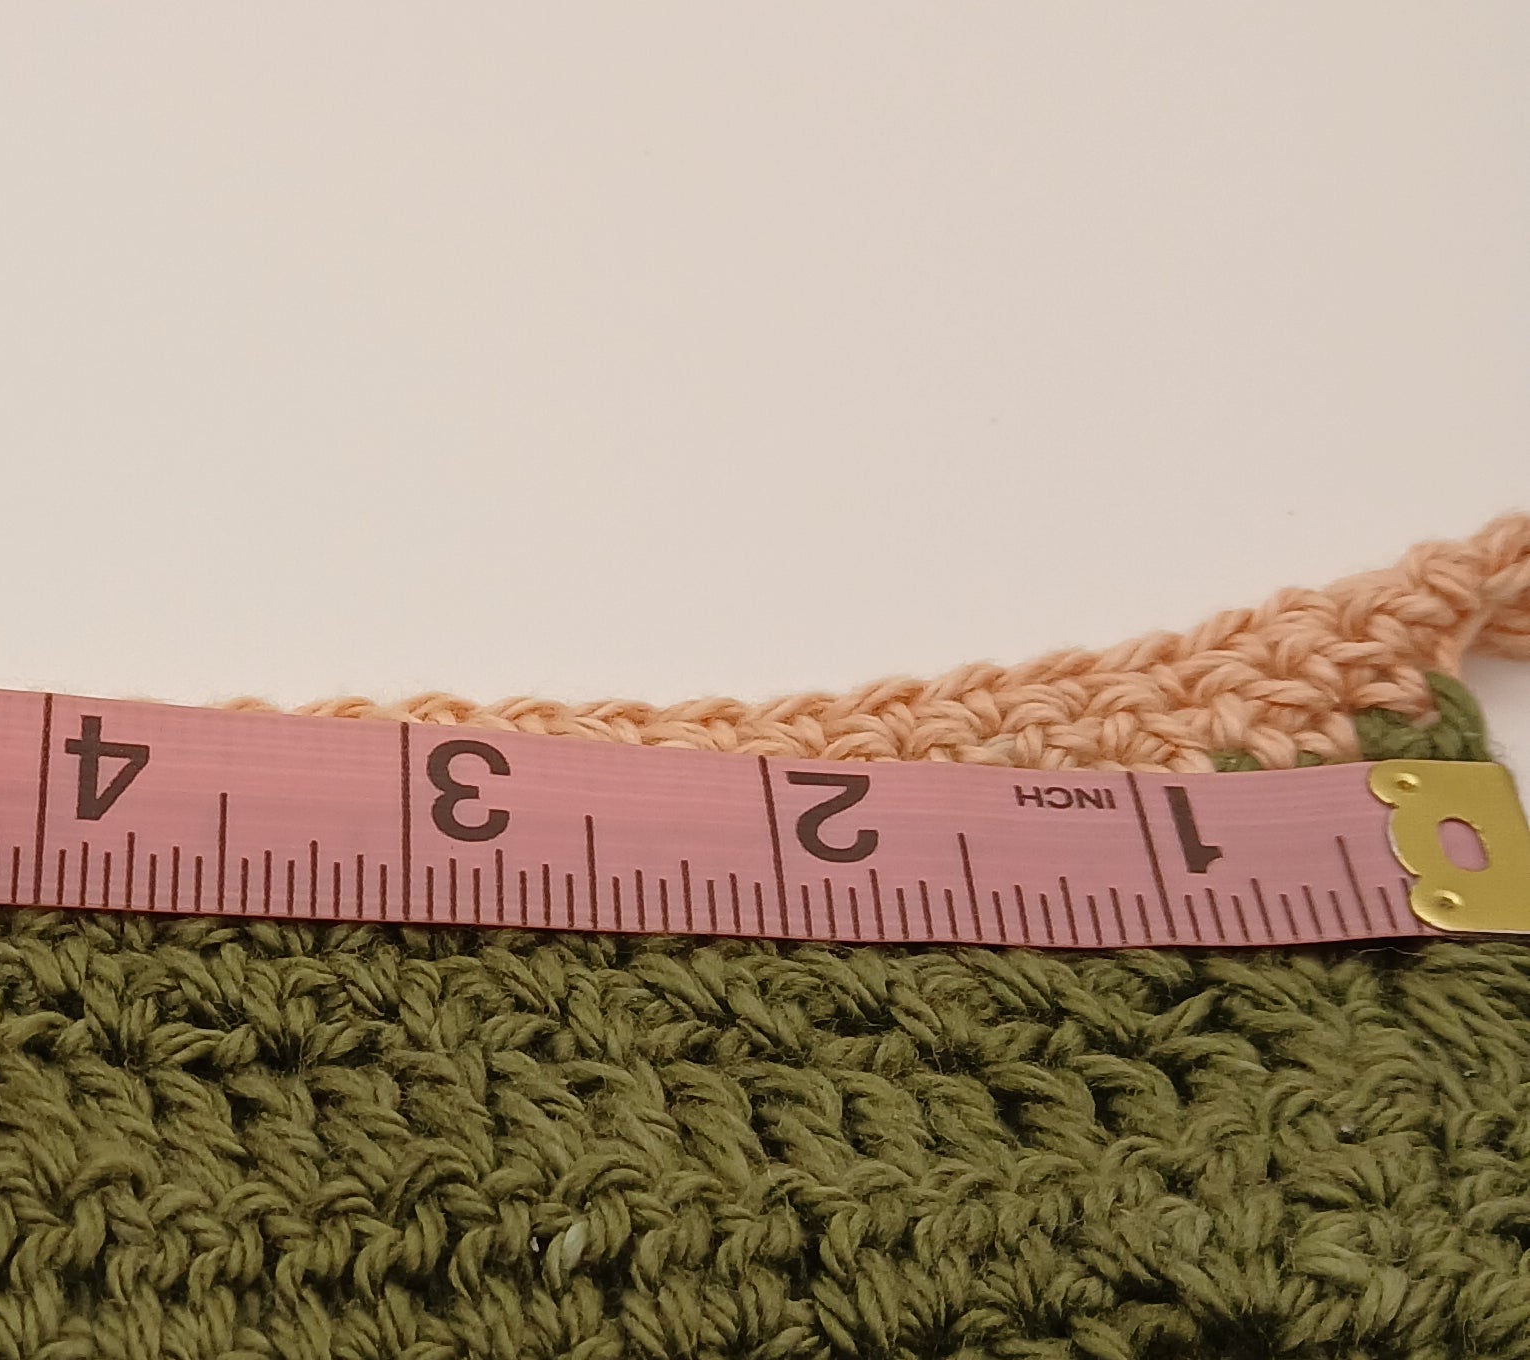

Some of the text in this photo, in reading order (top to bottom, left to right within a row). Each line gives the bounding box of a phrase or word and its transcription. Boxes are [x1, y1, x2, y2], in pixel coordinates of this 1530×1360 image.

[64, 714, 151, 821] 4
[426, 739, 511, 843] 3
[1014, 784, 1117, 811] INCH
[785, 770, 879, 864] 2
[1163, 785, 1224, 874] 1
